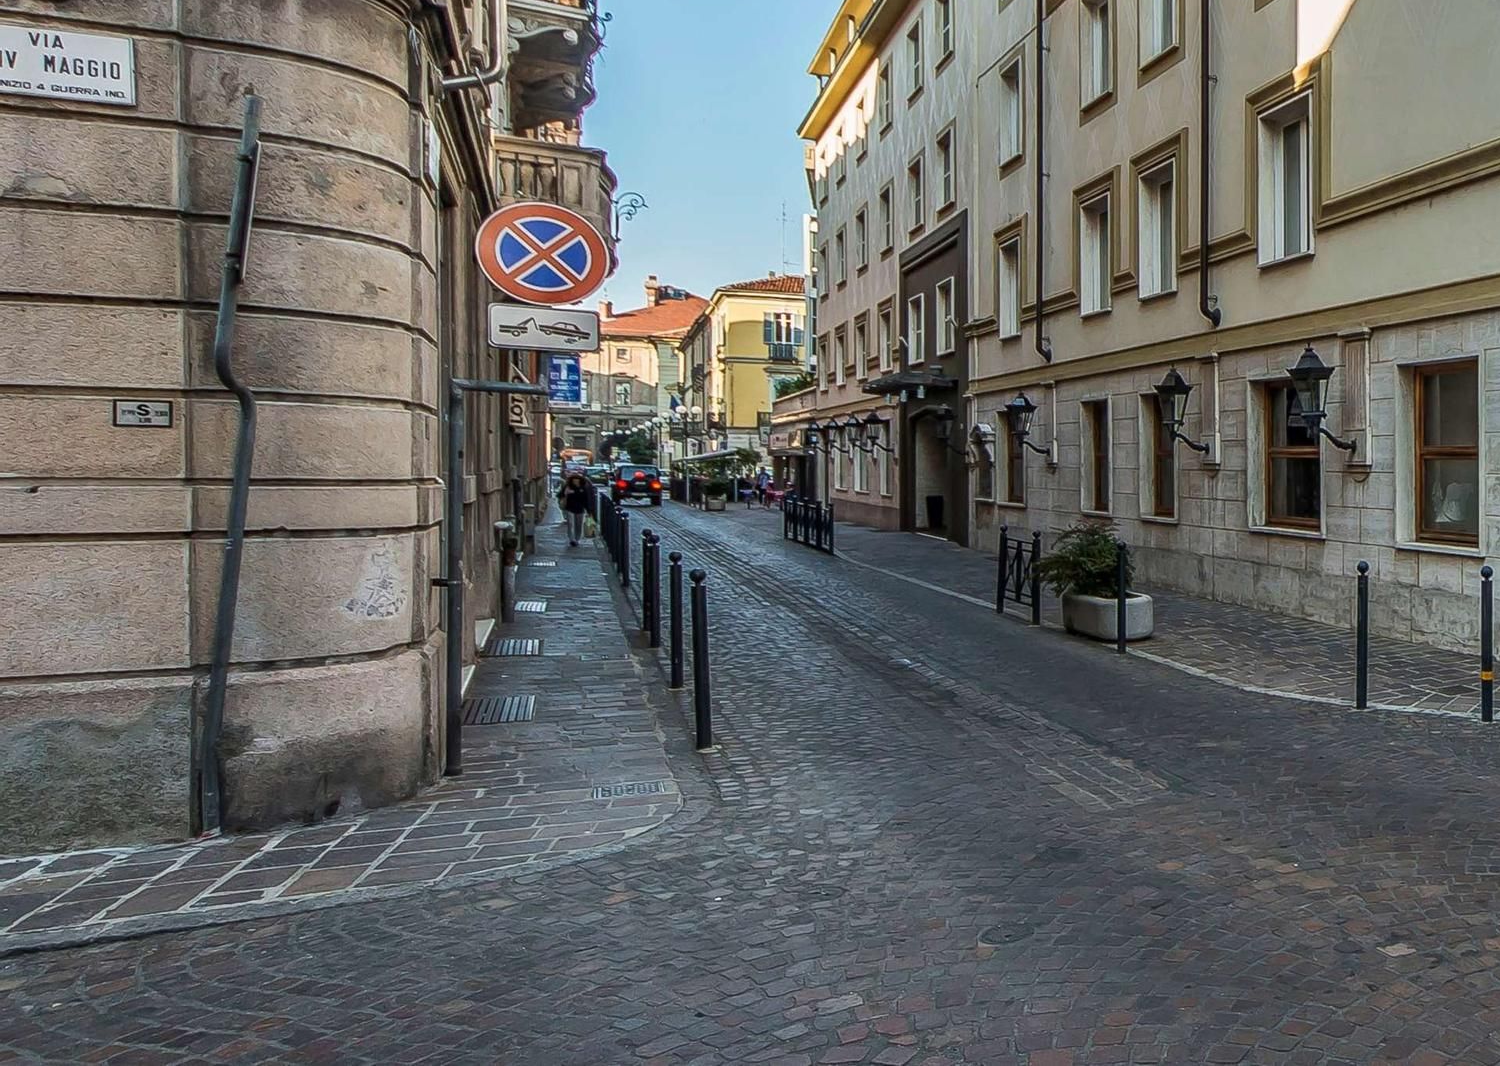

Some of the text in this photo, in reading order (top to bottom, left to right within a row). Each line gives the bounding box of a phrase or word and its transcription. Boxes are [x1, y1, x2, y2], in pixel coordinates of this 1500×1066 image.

[28, 31, 65, 50] VIA
[43, 54, 121, 80] MAGGIO
[50, 84, 101, 96] GUERRA
[552, 358, 576, 380] T
